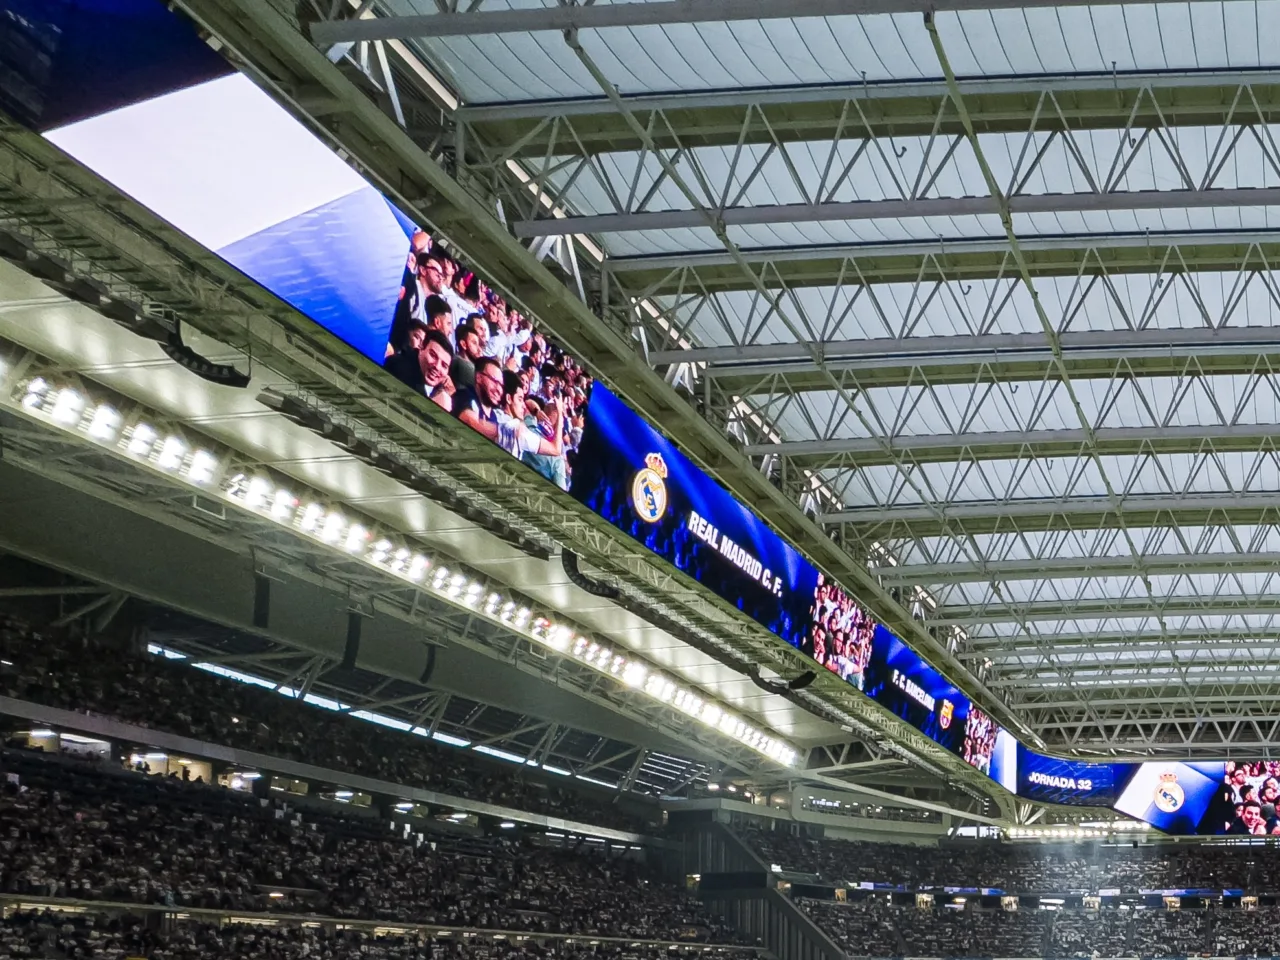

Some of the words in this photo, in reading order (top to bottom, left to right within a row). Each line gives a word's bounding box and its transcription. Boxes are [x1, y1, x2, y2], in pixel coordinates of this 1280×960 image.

[688, 510, 719, 550] REAL
[720, 534, 763, 580] MADRID
[762, 568, 772, 589] C.
[772, 576, 783, 598] F.
[1028, 771, 1076, 790] JORNADA
[1077, 779, 1092, 790] 32
